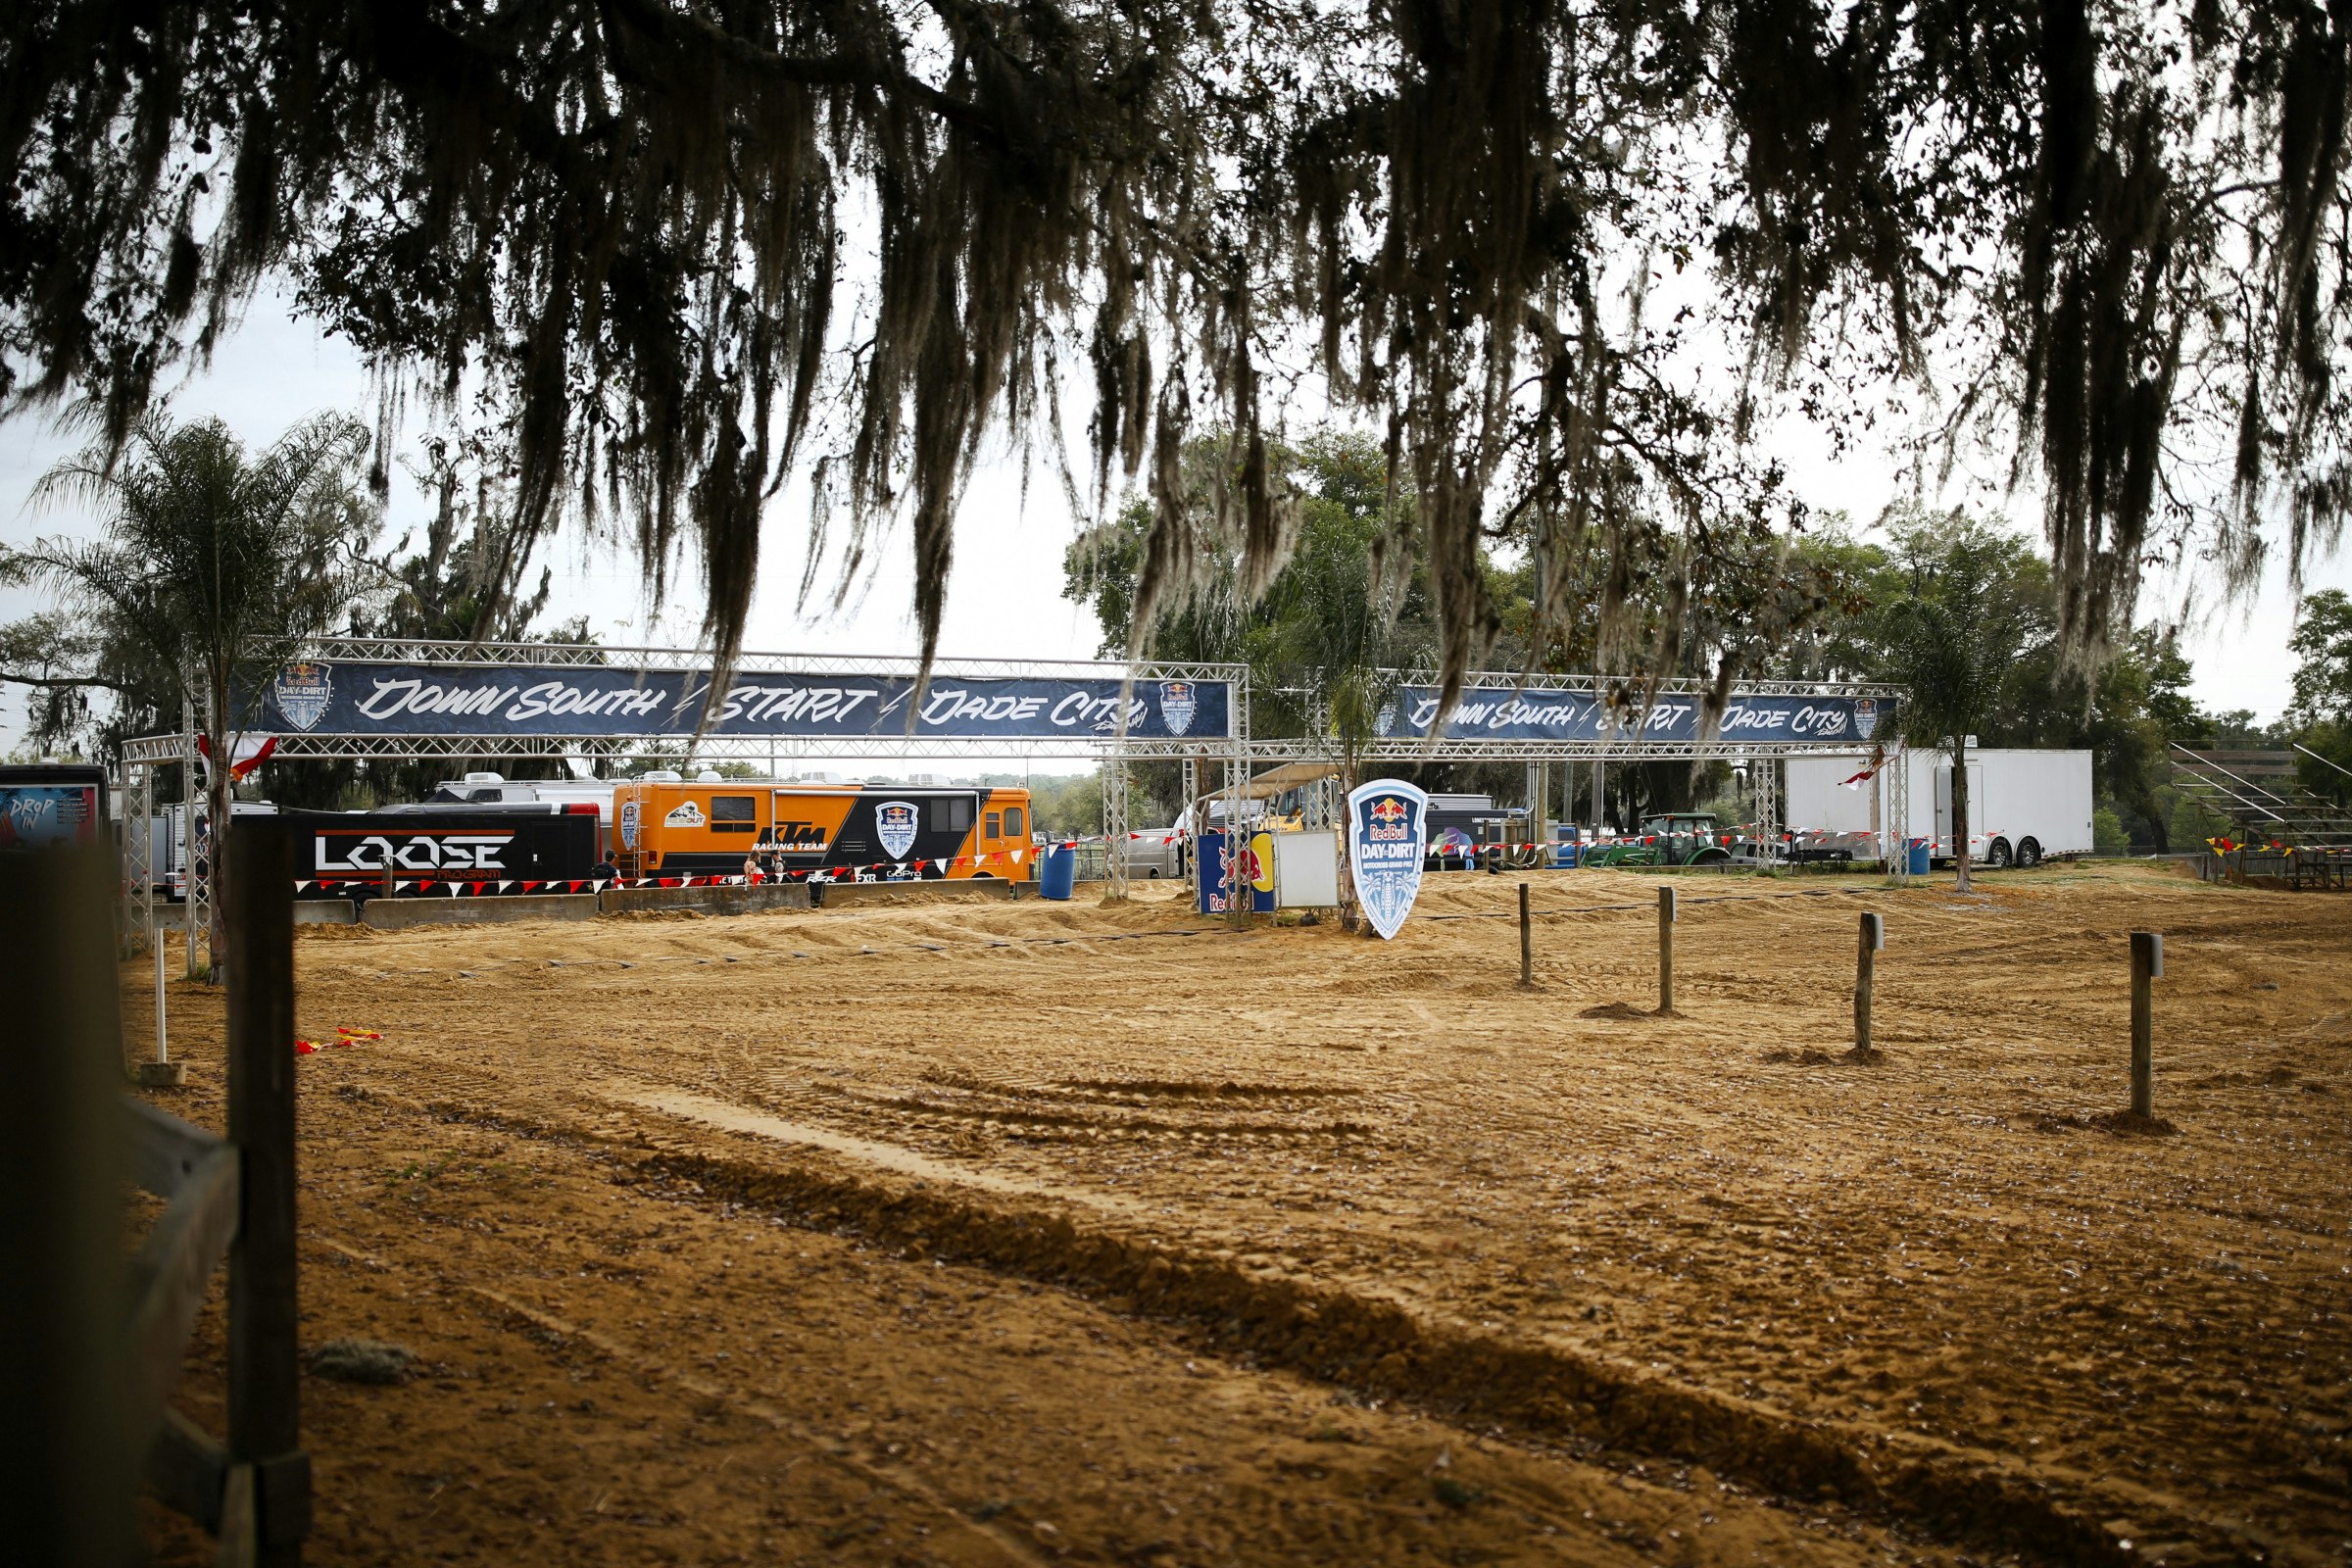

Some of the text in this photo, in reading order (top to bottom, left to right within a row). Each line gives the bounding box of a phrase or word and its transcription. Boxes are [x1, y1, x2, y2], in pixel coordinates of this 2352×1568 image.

[355, 677, 518, 720] DOWN
[506, 681, 666, 721] SOUTH
[706, 686, 878, 723] START
[918, 689, 1049, 725] DADE
[1488, 700, 1574, 729] SOUTH
[1791, 706, 1846, 733] CITY
[10, 799, 54, 817] DROP
[22, 813, 39, 829] IN
[757, 821, 826, 847] KTM
[316, 836, 514, 870] LOOSE
[1361, 843, 1415, 859] DAY DIRT
[436, 869, 502, 879] PROGRAM
